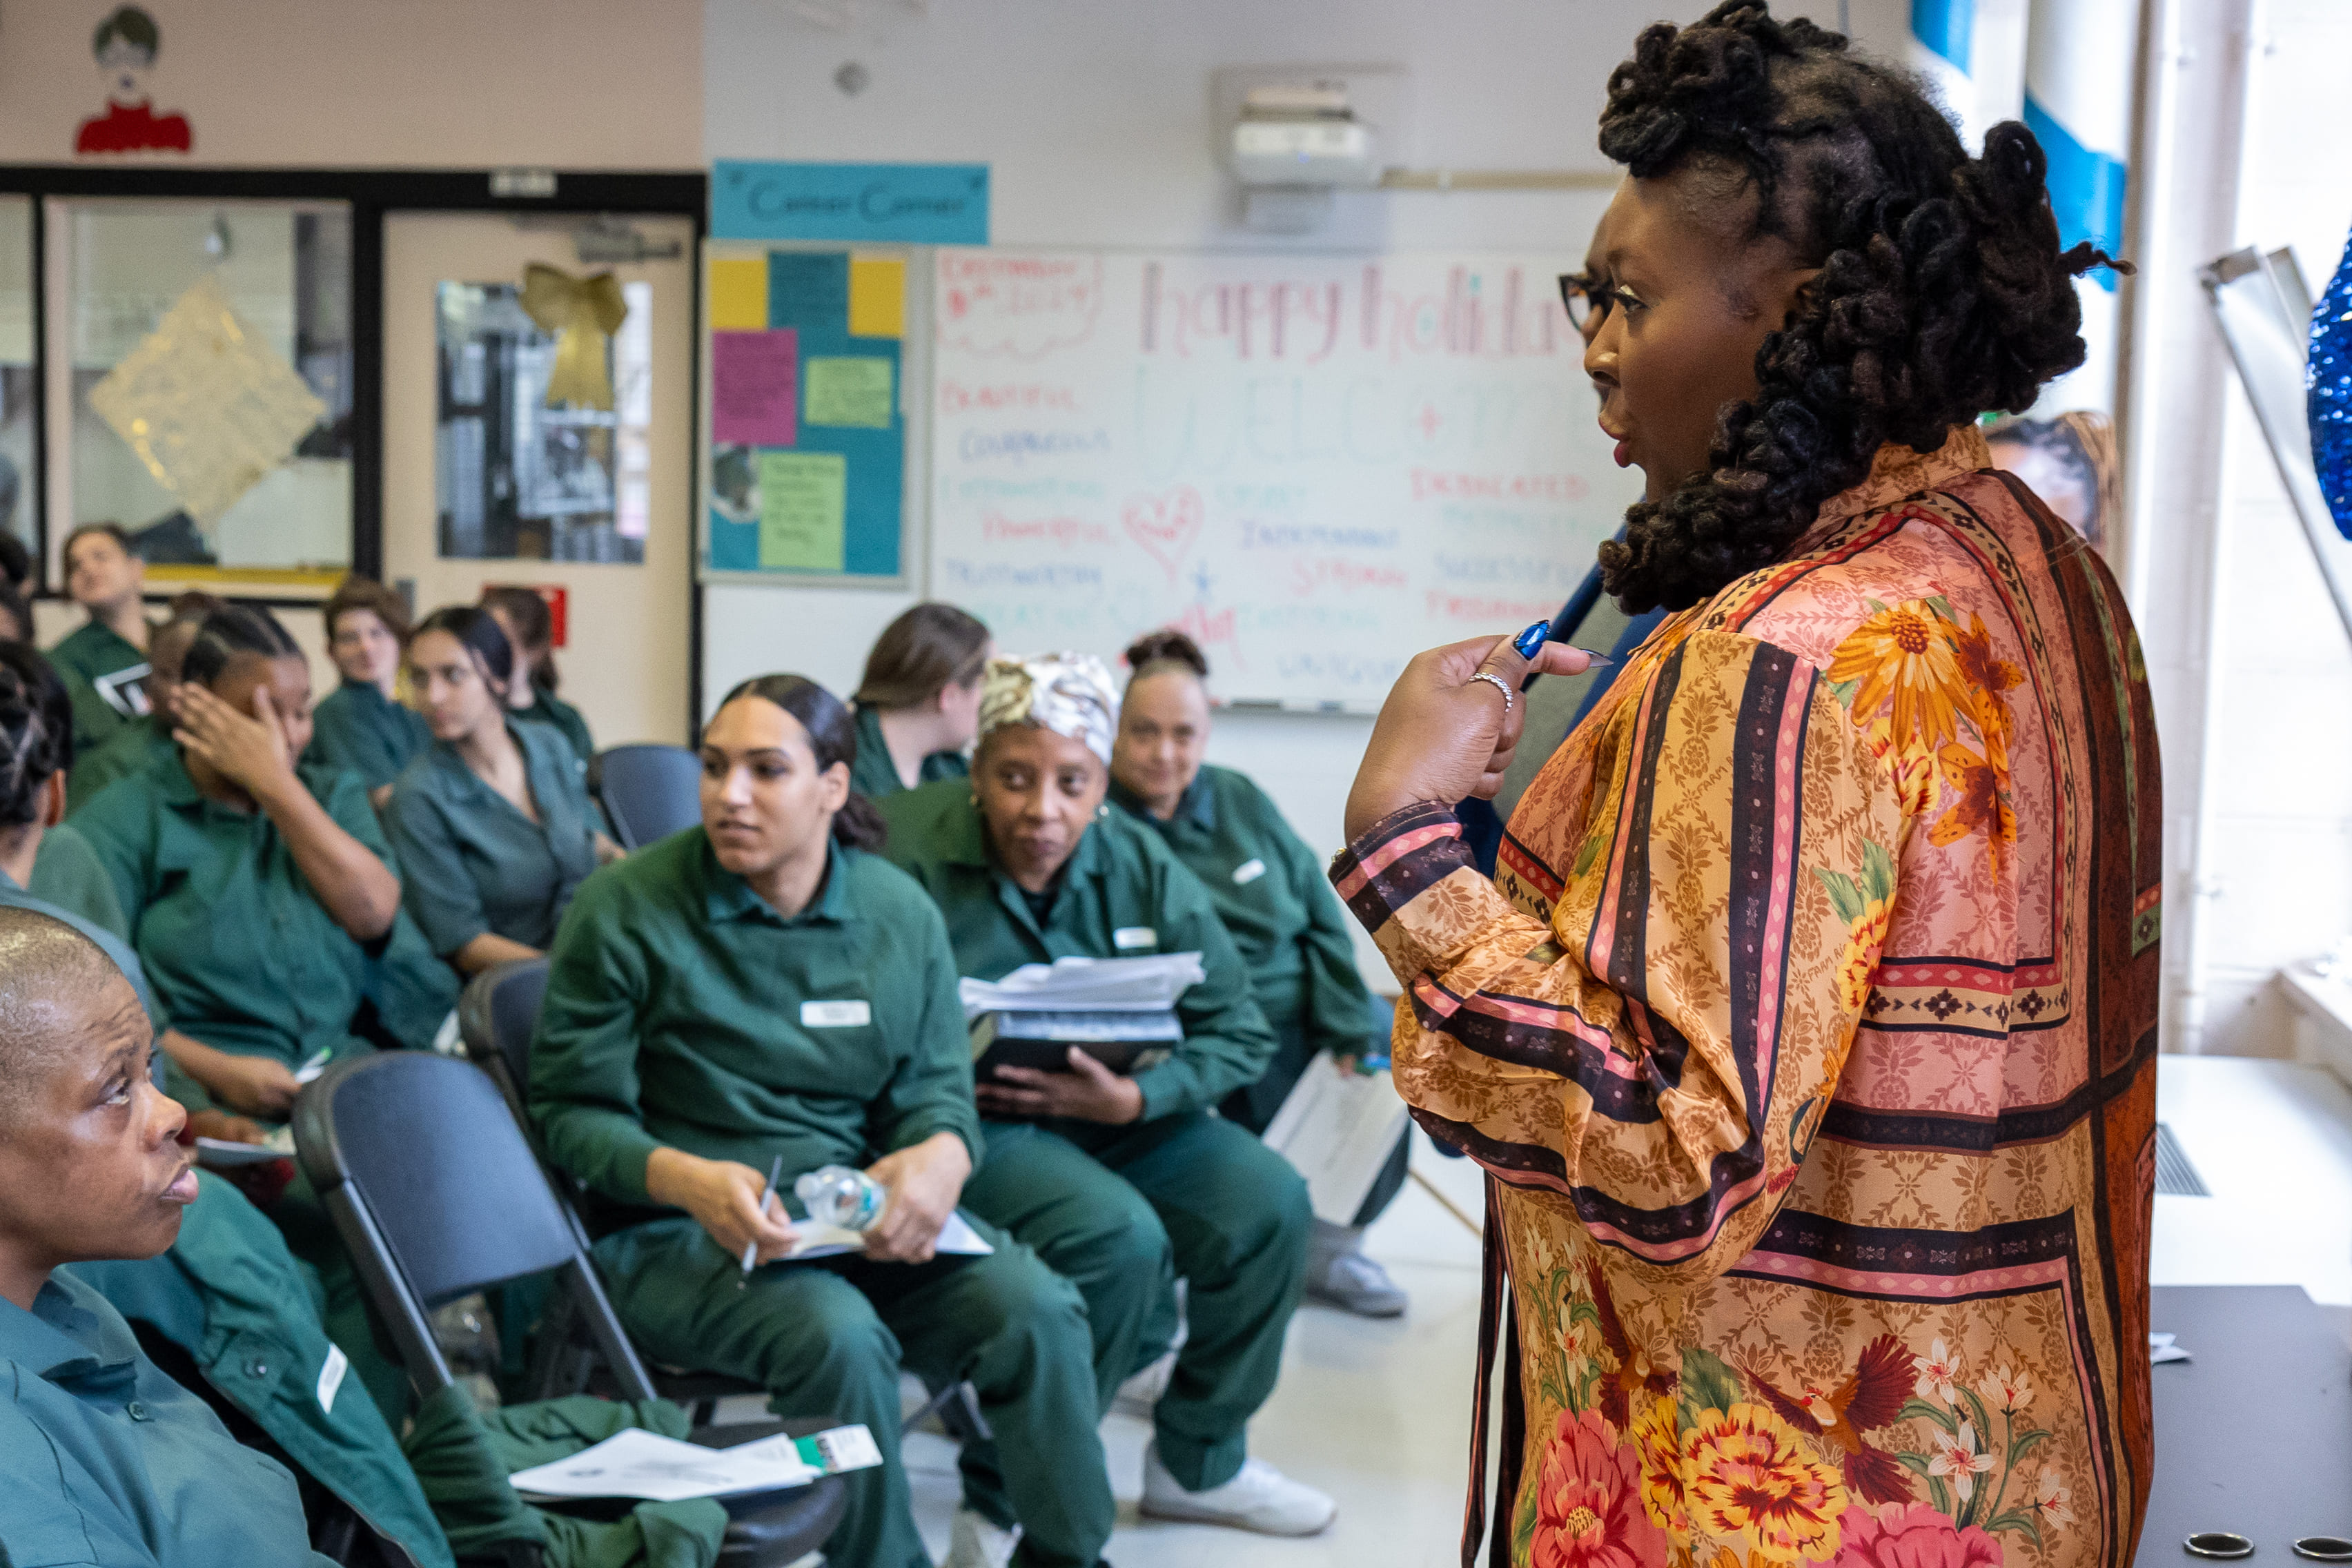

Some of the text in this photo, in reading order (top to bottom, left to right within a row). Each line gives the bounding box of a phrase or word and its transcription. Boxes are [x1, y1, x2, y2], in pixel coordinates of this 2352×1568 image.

[1137, 259, 1344, 369] happy
[1697, 765, 1729, 796] FARM
[1807, 956, 1834, 981] FARM
